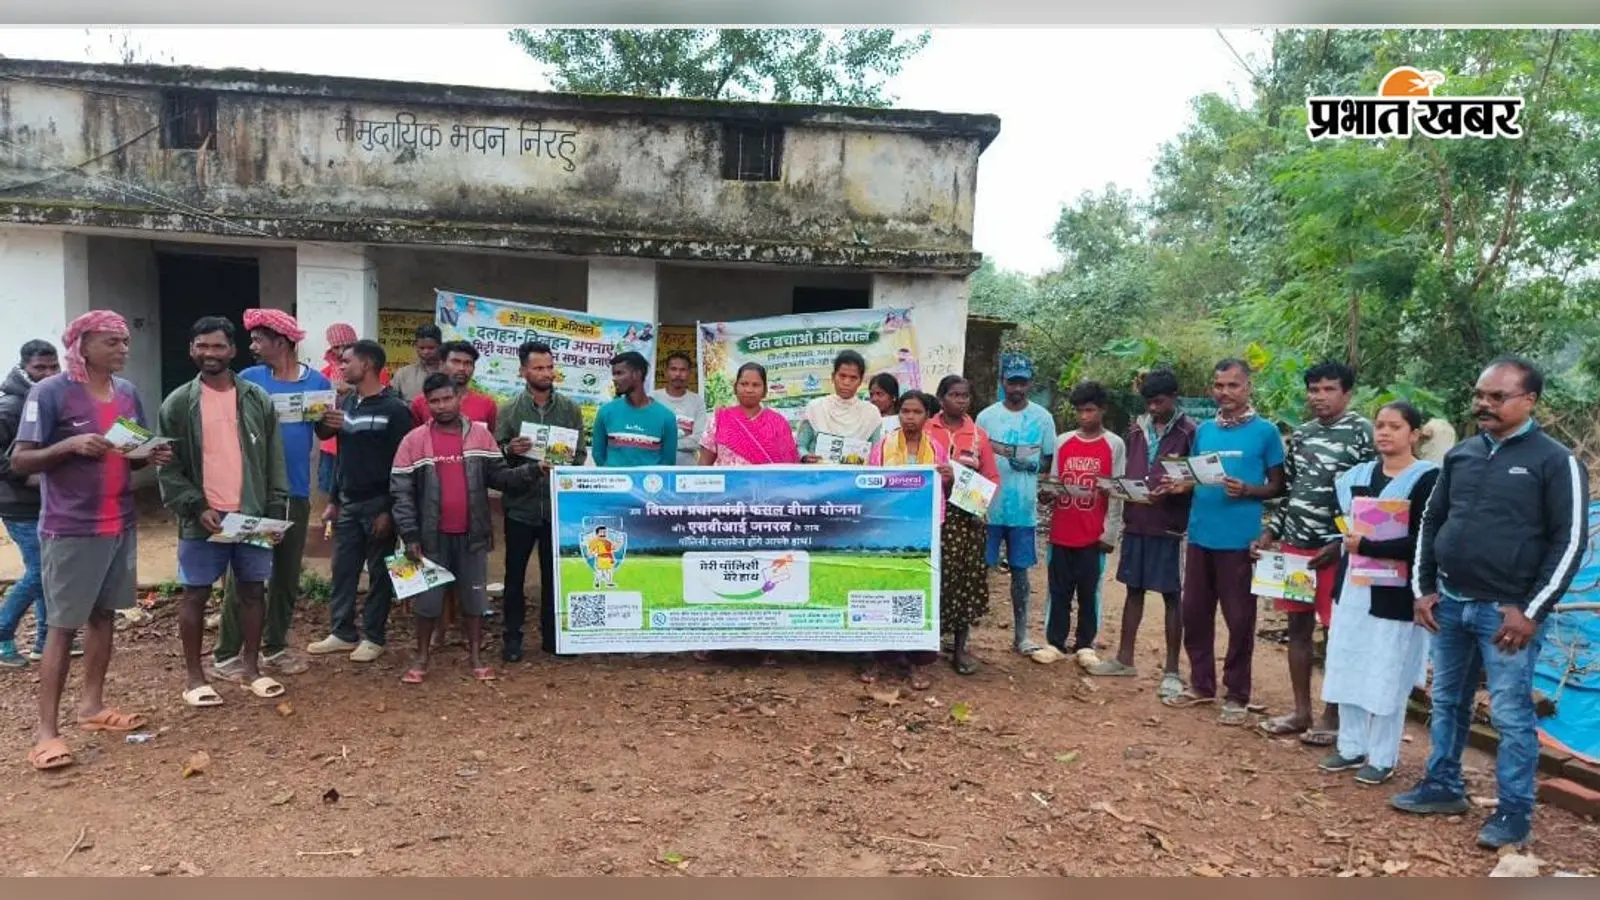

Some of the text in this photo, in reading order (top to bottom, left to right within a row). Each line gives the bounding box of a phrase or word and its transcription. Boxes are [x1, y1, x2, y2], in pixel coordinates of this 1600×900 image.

[450, 122, 510, 156] भवन
[747, 328, 870, 351] खेत बचाओ अभियान
[867, 476, 882, 486] SBI
[645, 501, 683, 517] बिरसा
[687, 502, 747, 517] प्रधानमंत्री
[750, 504, 785, 516] फसल
[787, 502, 816, 516] बीमा
[820, 502, 862, 515] योजना
[688, 517, 747, 535] एसबीआई
[750, 521, 792, 533] जनरल
[700, 559, 760, 571] मेरी पॉलिसी
[723, 570, 760, 582] मेरे हाथ
